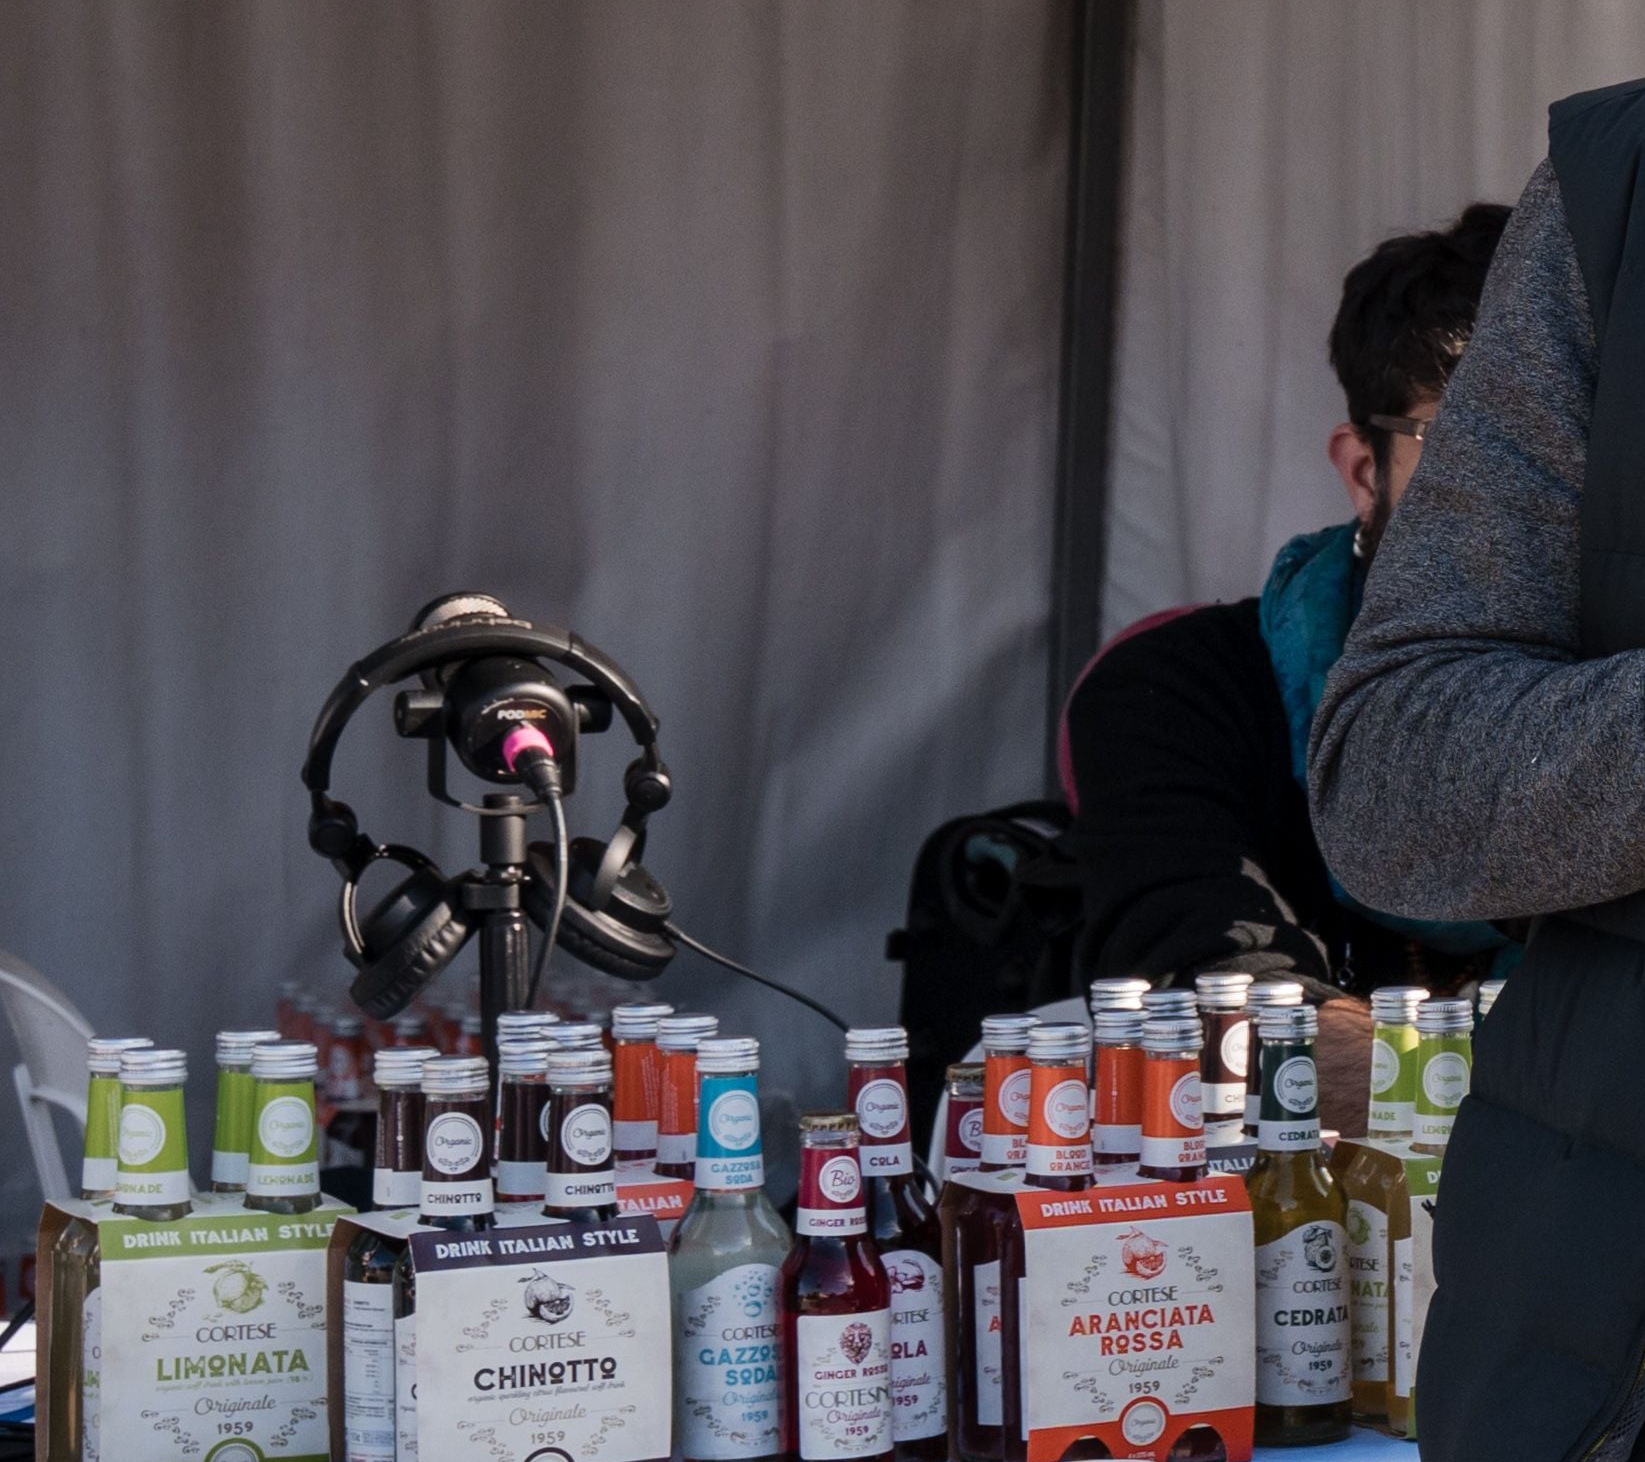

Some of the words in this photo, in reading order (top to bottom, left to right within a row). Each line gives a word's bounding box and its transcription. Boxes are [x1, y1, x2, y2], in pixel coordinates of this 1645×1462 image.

[870, 1156, 900, 1166] COLA
[1041, 1200, 1092, 1217] DRINK
[1099, 1195, 1167, 1213] ITALIAN
[1176, 1190, 1228, 1205] STYLE
[123, 1231, 181, 1249] DRINK
[190, 1228, 268, 1245] ITALIAN
[436, 1241, 492, 1259] DRINK
[500, 1235, 574, 1255] ITALIAN
[583, 1229, 639, 1247] STYLE
[1108, 1286, 1178, 1306] CORTESE
[1069, 1305, 1214, 1336] ARANCIATA
[1274, 1306, 1348, 1327] CEDRATA
[196, 1323, 277, 1343] CORTESE
[509, 1331, 587, 1353] CORTESE
[1101, 1330, 1184, 1356] ROSSA
[156, 1349, 310, 1382] LIMONATA
[474, 1357, 617, 1391] CHINOTTO
[815, 1369, 856, 1380] GINGER
[1109, 1356, 1179, 1377] Originale
[1129, 1381, 1160, 1394] 1959
[194, 1394, 277, 1417] Originale
[509, 1403, 587, 1428] Originale
[217, 1421, 253, 1435] 1959
[531, 1431, 565, 1444] 1959
